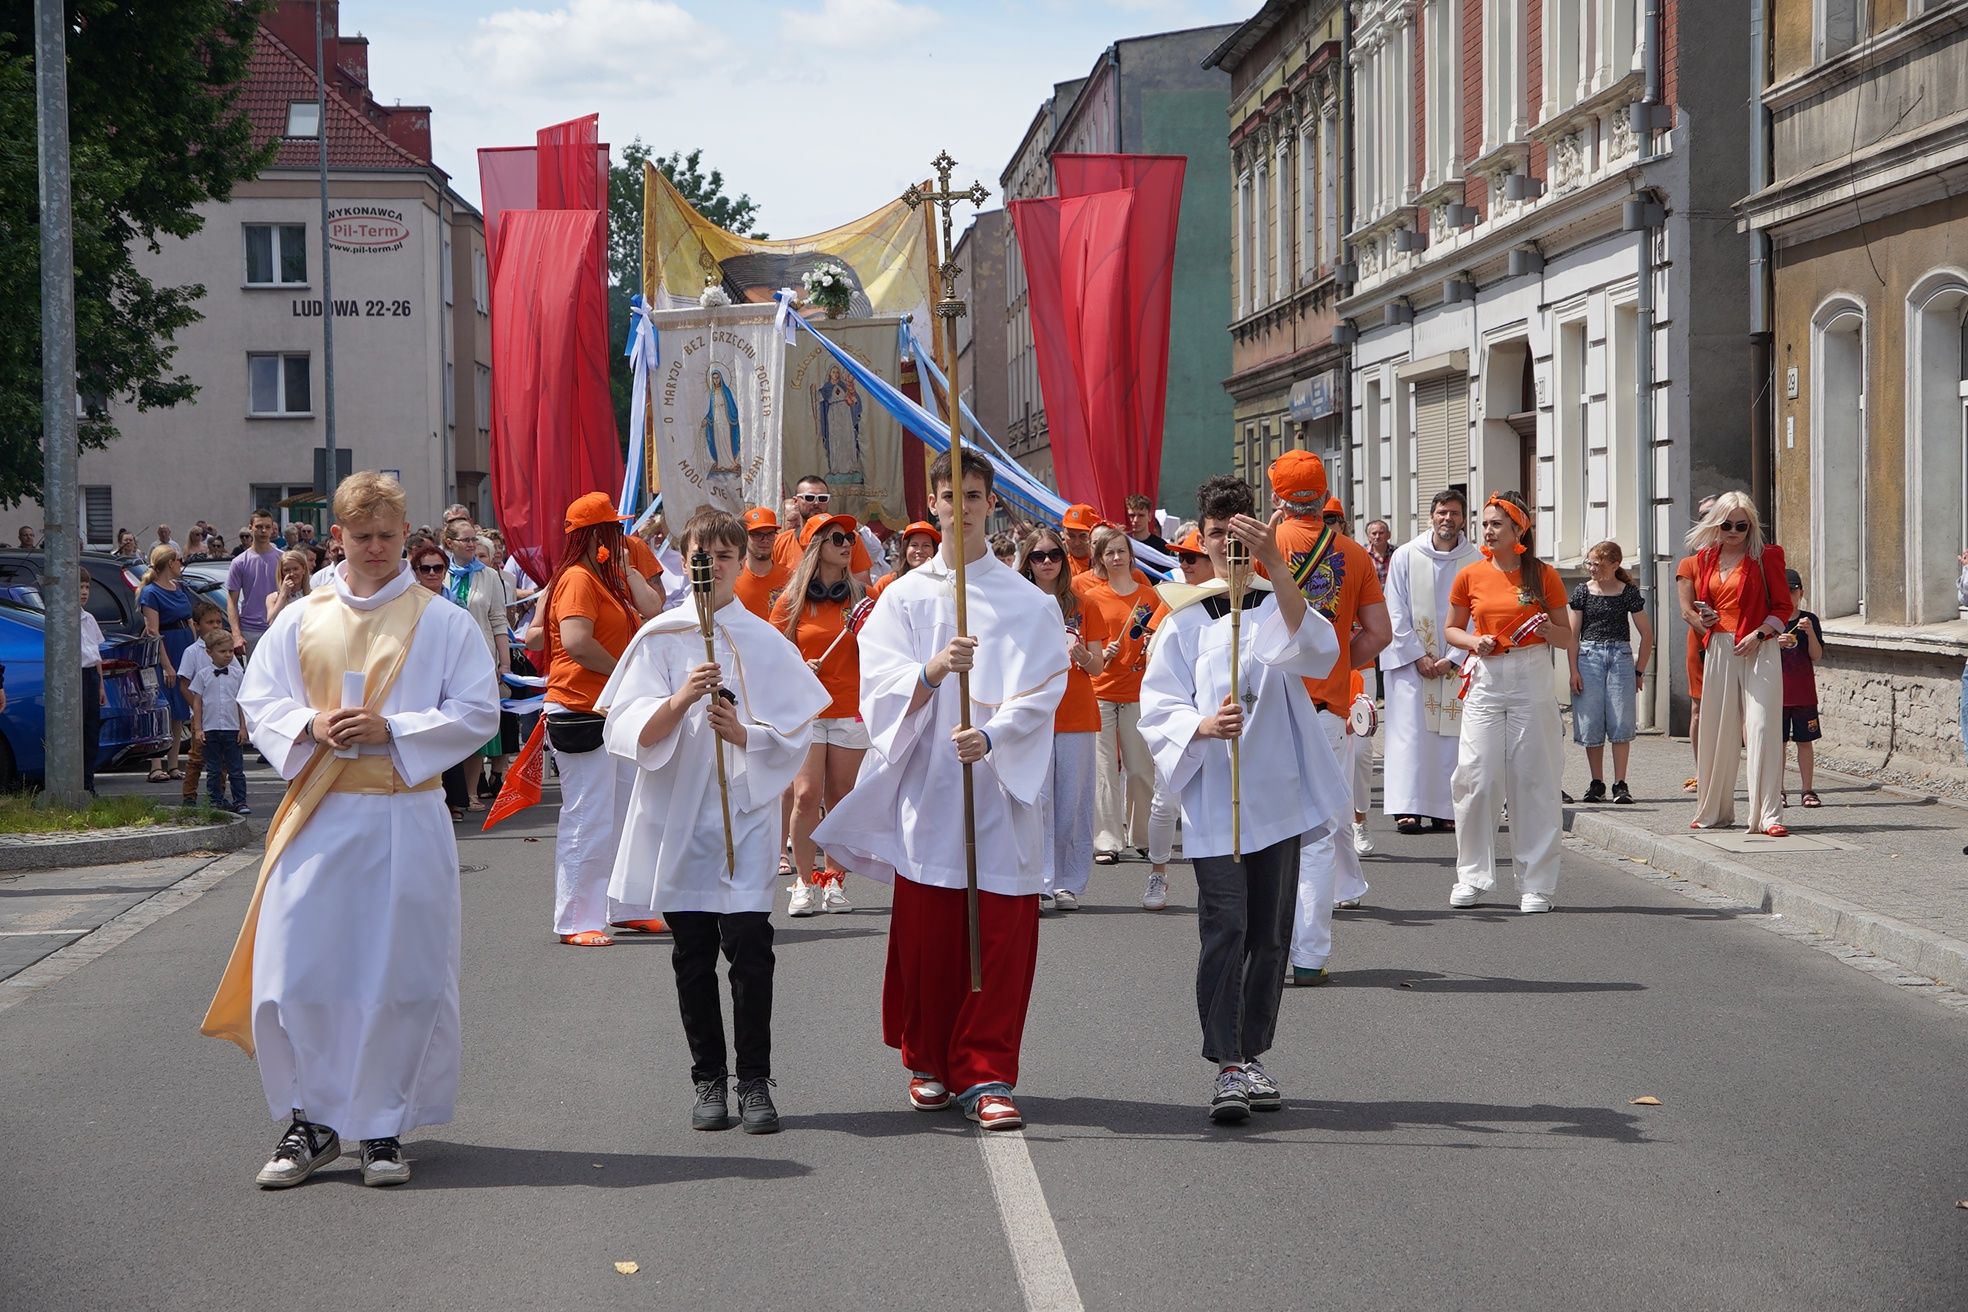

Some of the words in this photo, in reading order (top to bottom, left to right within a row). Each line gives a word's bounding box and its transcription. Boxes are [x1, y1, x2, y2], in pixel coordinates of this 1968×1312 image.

[327, 207, 403, 221] WYKONAWCA
[333, 225, 398, 237] Pil-Term
[292, 300, 360, 317] LUDWA
[365, 300, 411, 317] 22-26
[663, 360, 683, 406] MARYJO
[683, 336, 706, 356] BEZ
[712, 331, 756, 359] GRZECHU
[1788, 373, 1796, 391] 29
